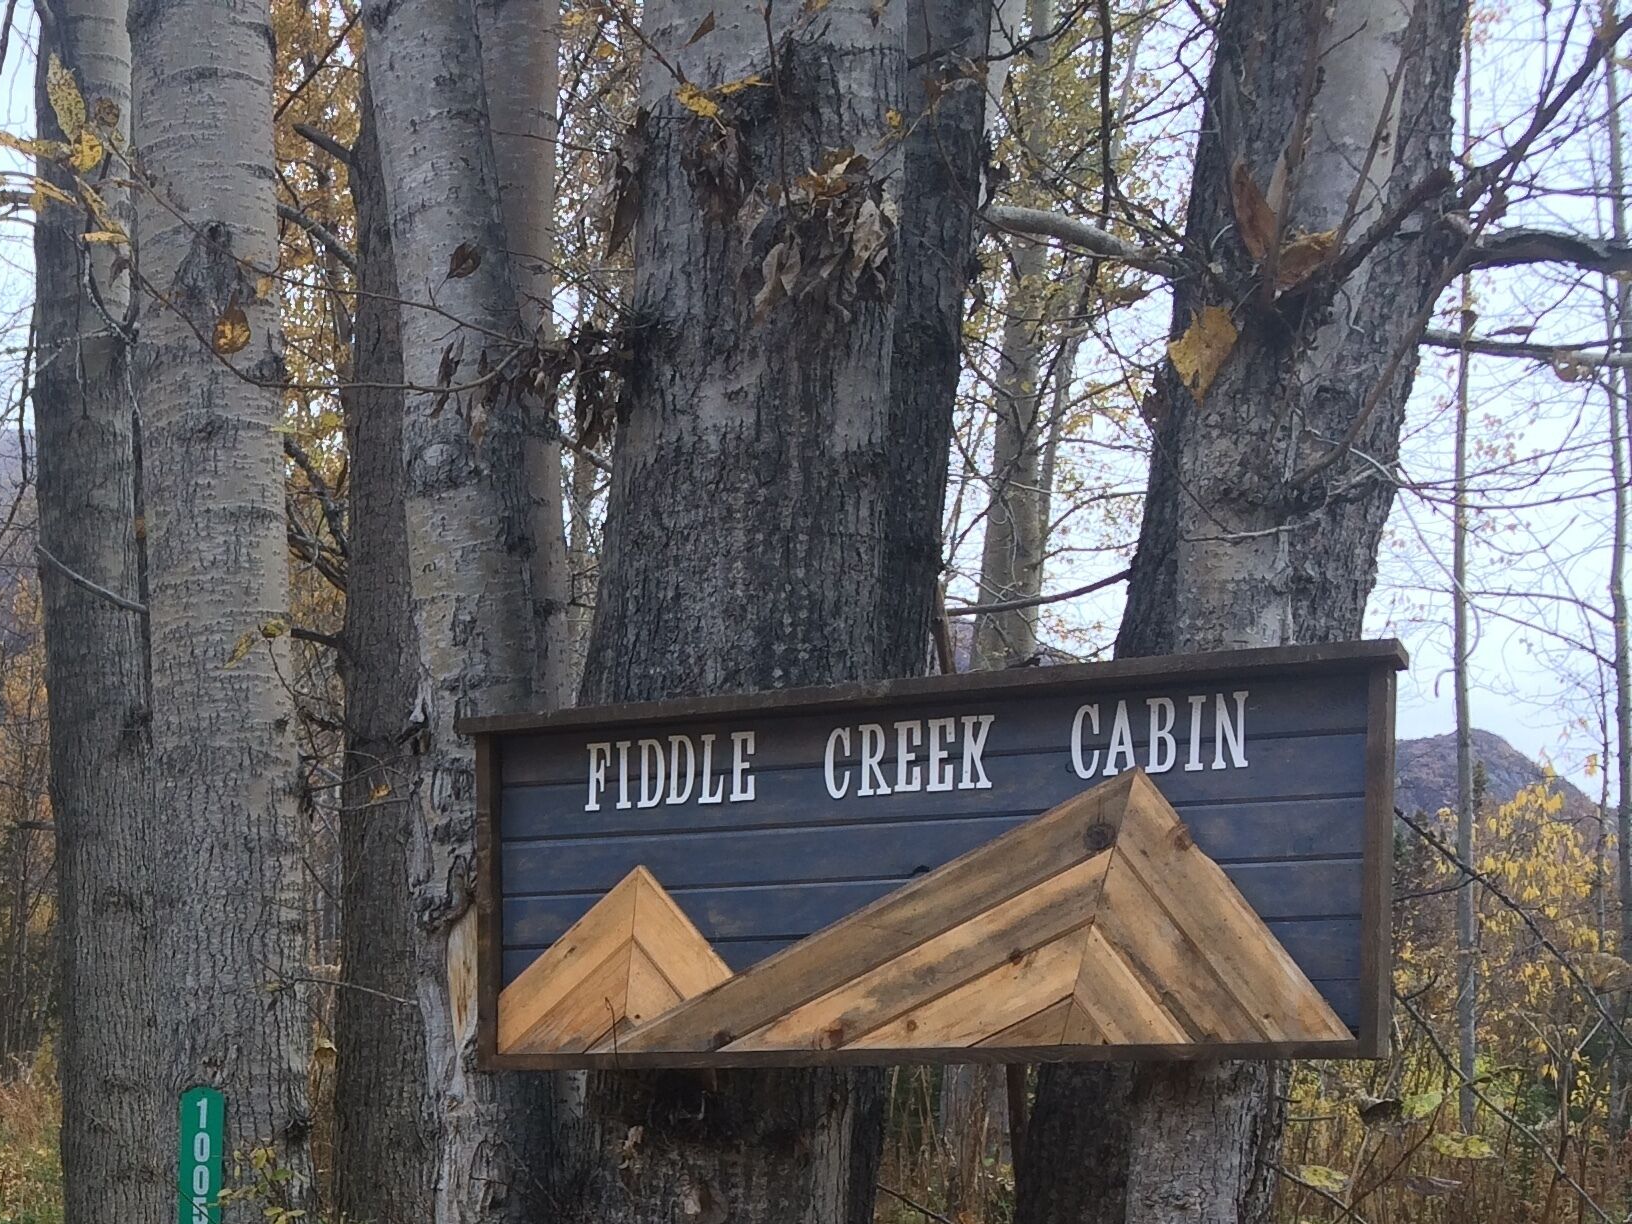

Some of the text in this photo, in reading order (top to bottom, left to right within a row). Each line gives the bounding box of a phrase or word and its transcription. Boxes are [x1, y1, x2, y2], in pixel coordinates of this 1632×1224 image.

[583, 690, 1251, 812] FIDDLE CREEK CABIN
